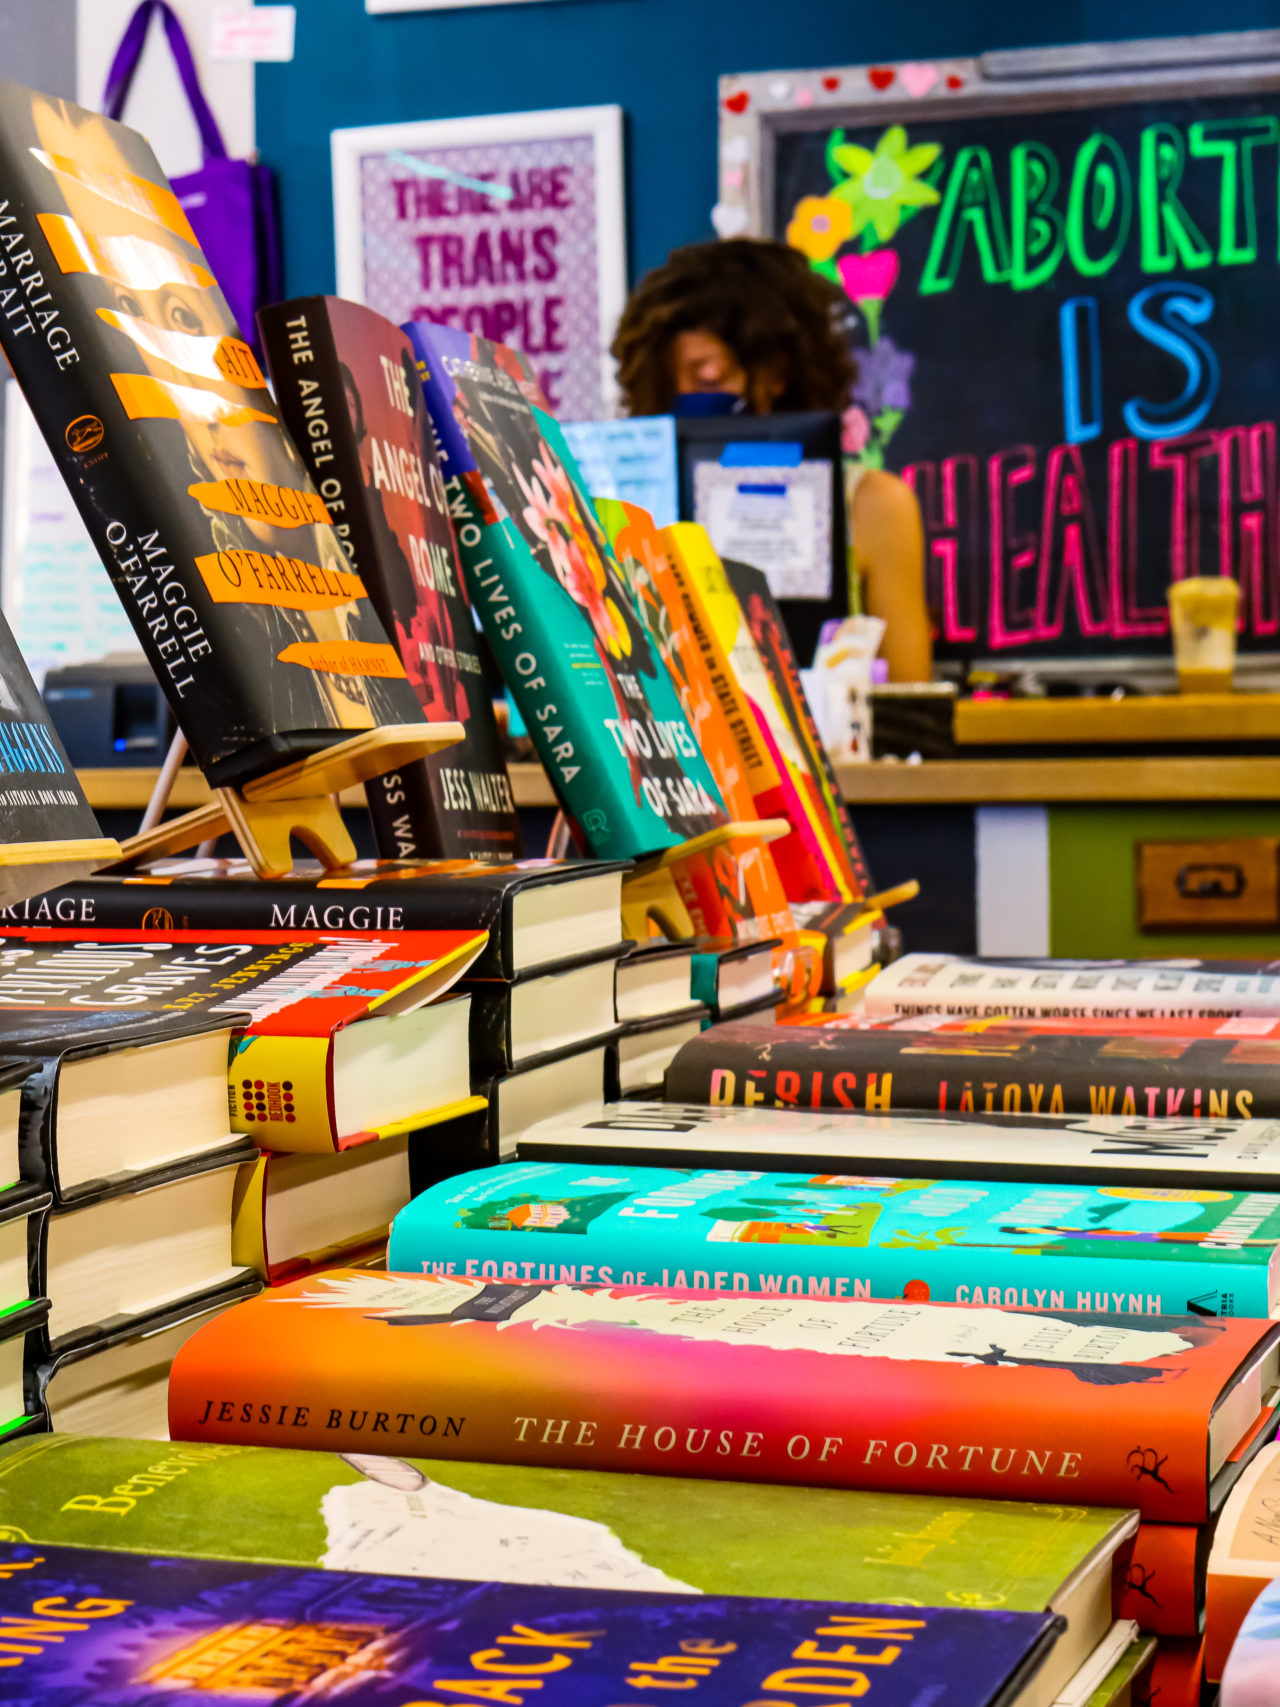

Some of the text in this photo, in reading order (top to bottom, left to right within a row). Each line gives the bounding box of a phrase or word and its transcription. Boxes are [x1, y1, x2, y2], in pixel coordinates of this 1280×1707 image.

[918, 116, 1280, 296] ABORT
[415, 225, 559, 290] TRANS
[286, 315, 314, 365] THE
[1060, 280, 1221, 445] IS
[380, 355, 413, 417] THE
[297, 379, 334, 468] ANGEL
[224, 479, 324, 524] MAGGIE
[320, 479, 346, 513] OF
[371, 436, 431, 507] ANGEL
[217, 551, 352, 599] O'FARRELL
[408, 534, 456, 597] ROME
[105, 521, 197, 699] O'FARRELL
[137, 529, 212, 664] MAGGIE
[444, 475, 581, 784] TWO LIVES OF SARA
[351, 657, 390, 674] HAMNET
[603, 718, 698, 759] TWO LIVES
[440, 768, 515, 814] JESS WALTER
[640, 777, 717, 818] OF SARA
[270, 904, 404, 930] MAGGIE
[70, 944, 253, 1007] GRAVES
[267, 1081, 283, 1121] REDHOOK
[1089, 1085, 1254, 1118] WATKINS
[421, 1258, 1162, 1316] THE FORTUNES OF JADED WOMEN CAROLYN HUYNH
[199, 1400, 1084, 1479] JESSIE BURTON THE HOUSE OF FORTUNE
[399, 1623, 607, 1707] ACK
[624, 1637, 738, 1689] the
